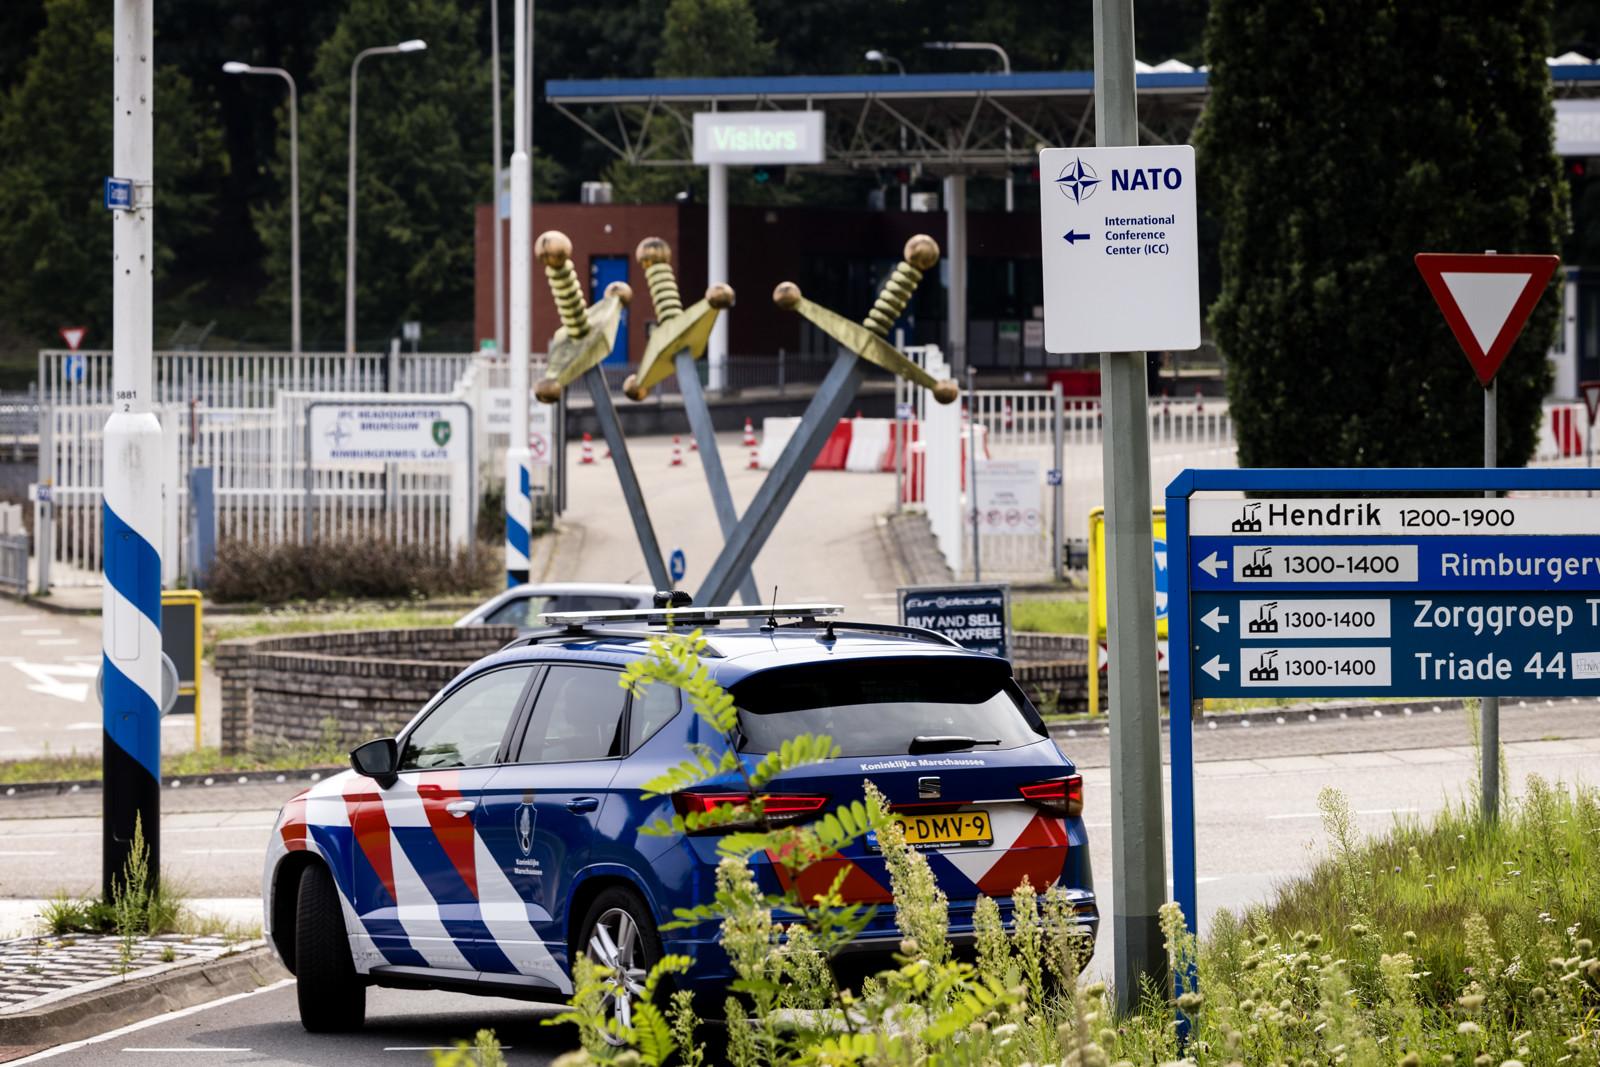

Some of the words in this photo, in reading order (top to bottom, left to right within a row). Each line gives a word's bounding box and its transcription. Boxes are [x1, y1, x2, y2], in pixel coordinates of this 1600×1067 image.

[712, 125, 798, 151] Visitors
[1111, 167, 1183, 191] NATO
[1104, 214, 1175, 226] International
[1105, 230, 1166, 241] Conference
[1105, 245, 1142, 255] Center
[1144, 243, 1170, 256] (ICC)
[124, 403, 131, 412] 2
[1268, 503, 1382, 527] Hendrik
[1399, 509, 1516, 527] 1200-1900
[1284, 556, 1400, 574] 1300-1400
[907, 616, 936, 629] BUY
[937, 615, 966, 628] AND
[967, 613, 1002, 627] SELL
[1284, 611, 1376, 628] 1300-1400
[1413, 599, 1574, 636] Zorggroep
[944, 627, 1002, 640] TAXFREE
[1285, 659, 1377, 676] 1300-1400
[1414, 652, 1513, 681] Triade
[1523, 651, 1567, 680] 44
[860, 759, 917, 771] Koninklijke
[918, 758, 986, 767] Marechaussee
